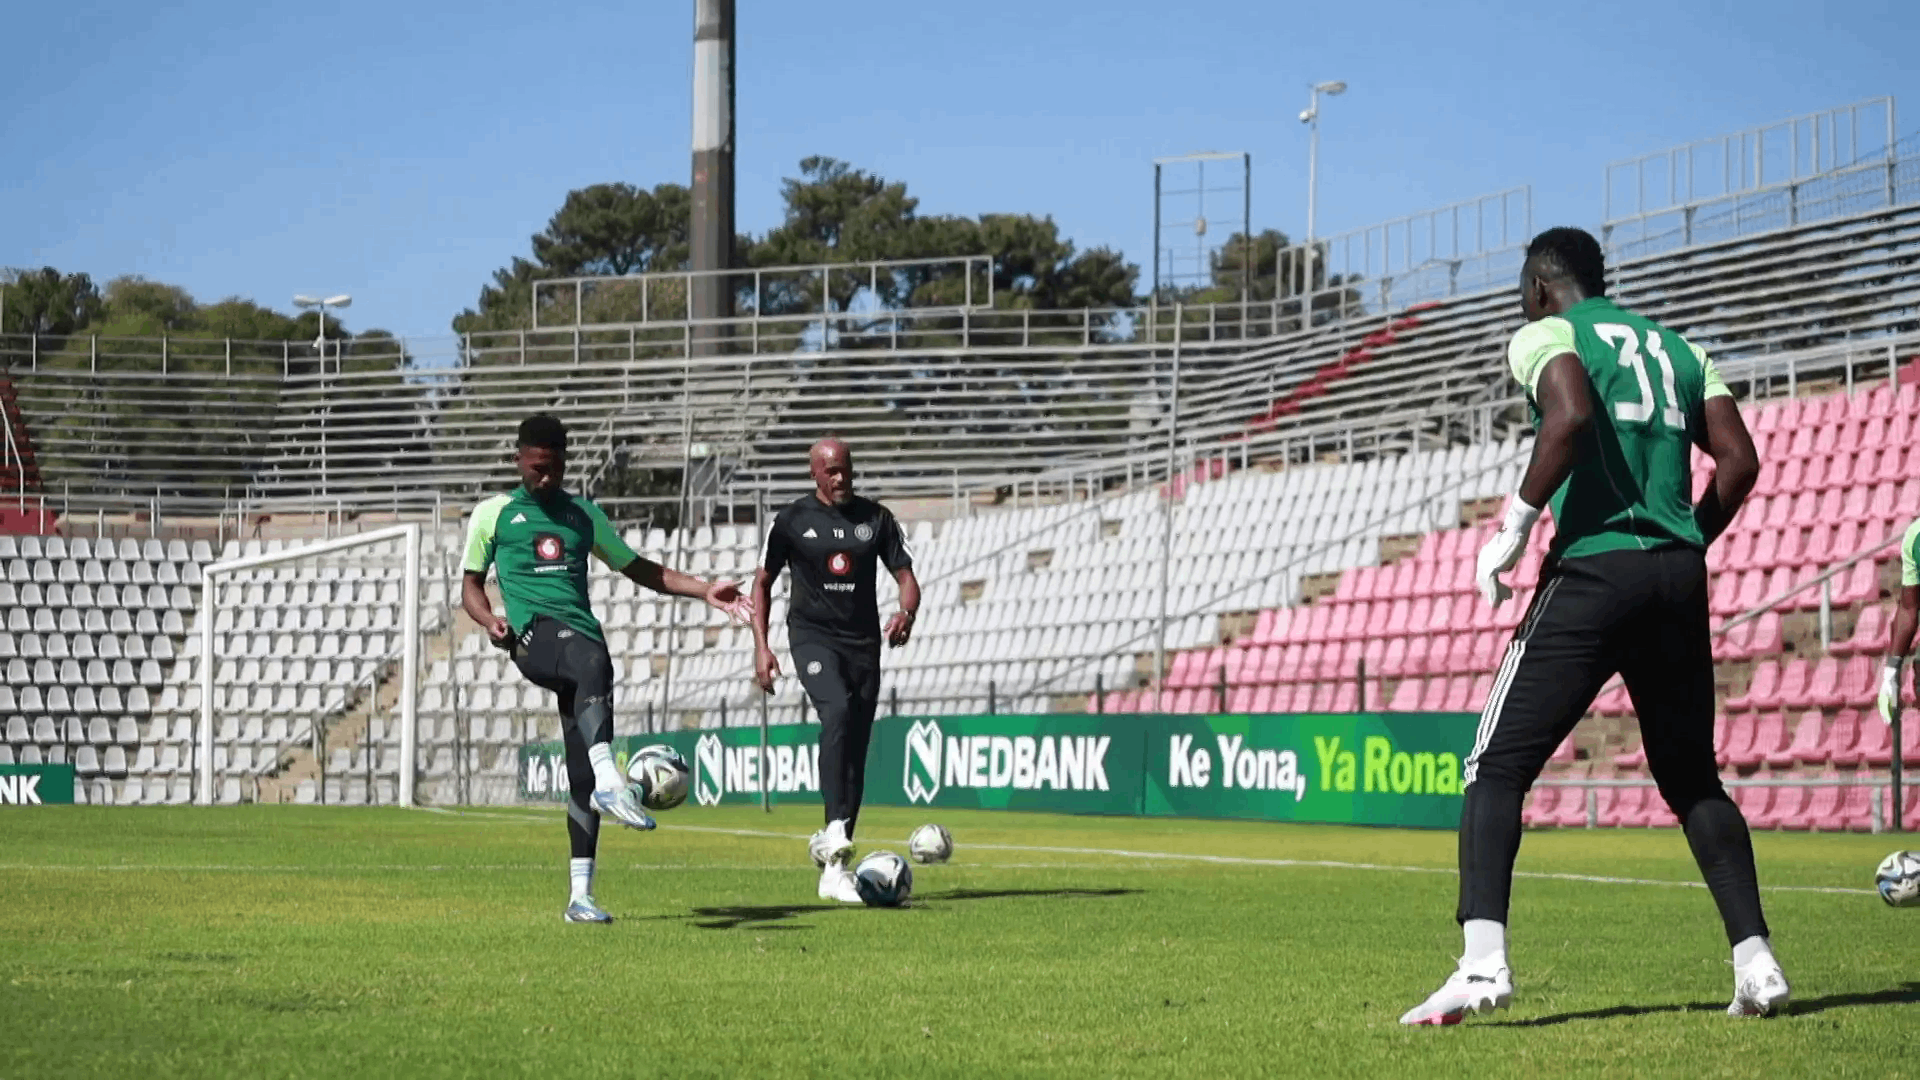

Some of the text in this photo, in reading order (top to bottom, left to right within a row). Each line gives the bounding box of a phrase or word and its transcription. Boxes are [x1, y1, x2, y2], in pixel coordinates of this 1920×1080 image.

[1593, 322, 1686, 431] 31
[0, 775, 42, 804] NK
[527, 755, 548, 793] Ke
[725, 743, 821, 793] NEDBA
[944, 735, 1112, 792] NEDBANK
[1168, 733, 1212, 789] Ke
[1217, 733, 1307, 803] Yona,
[1313, 735, 1356, 793] Ya
